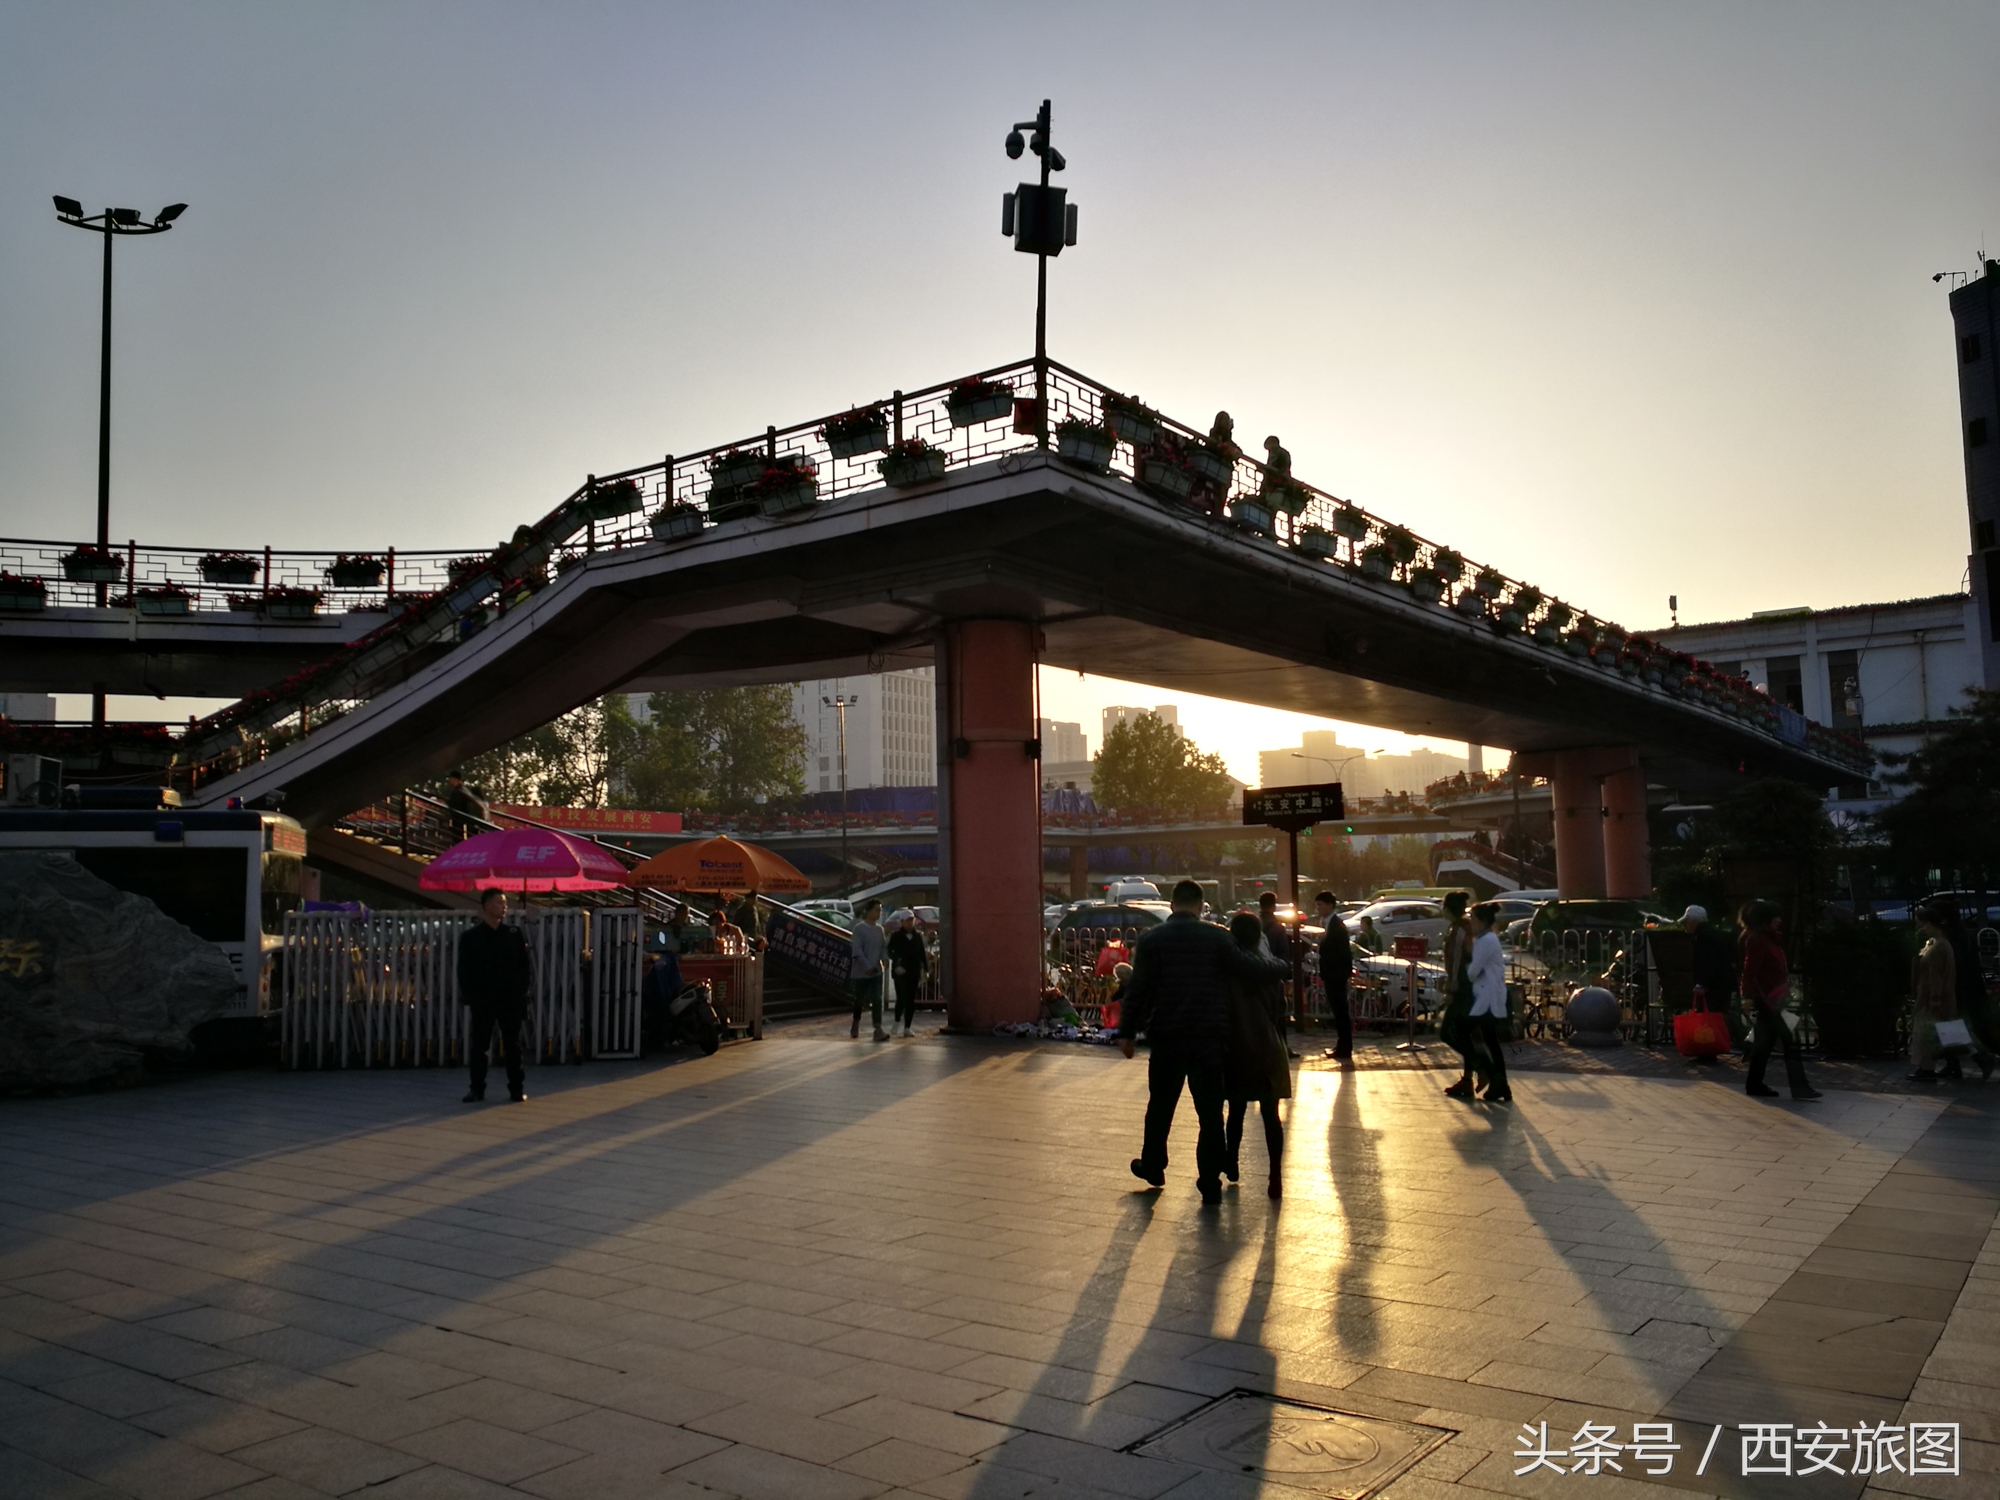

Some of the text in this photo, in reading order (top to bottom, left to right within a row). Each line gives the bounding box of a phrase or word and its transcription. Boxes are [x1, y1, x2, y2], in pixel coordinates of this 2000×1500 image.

[1263, 796, 1322, 811] 长安中路
[528, 807, 653, 824] 硬科技发展西安
[517, 846, 557, 860] EF
[773, 926, 851, 971] 请自觉靠右行走
